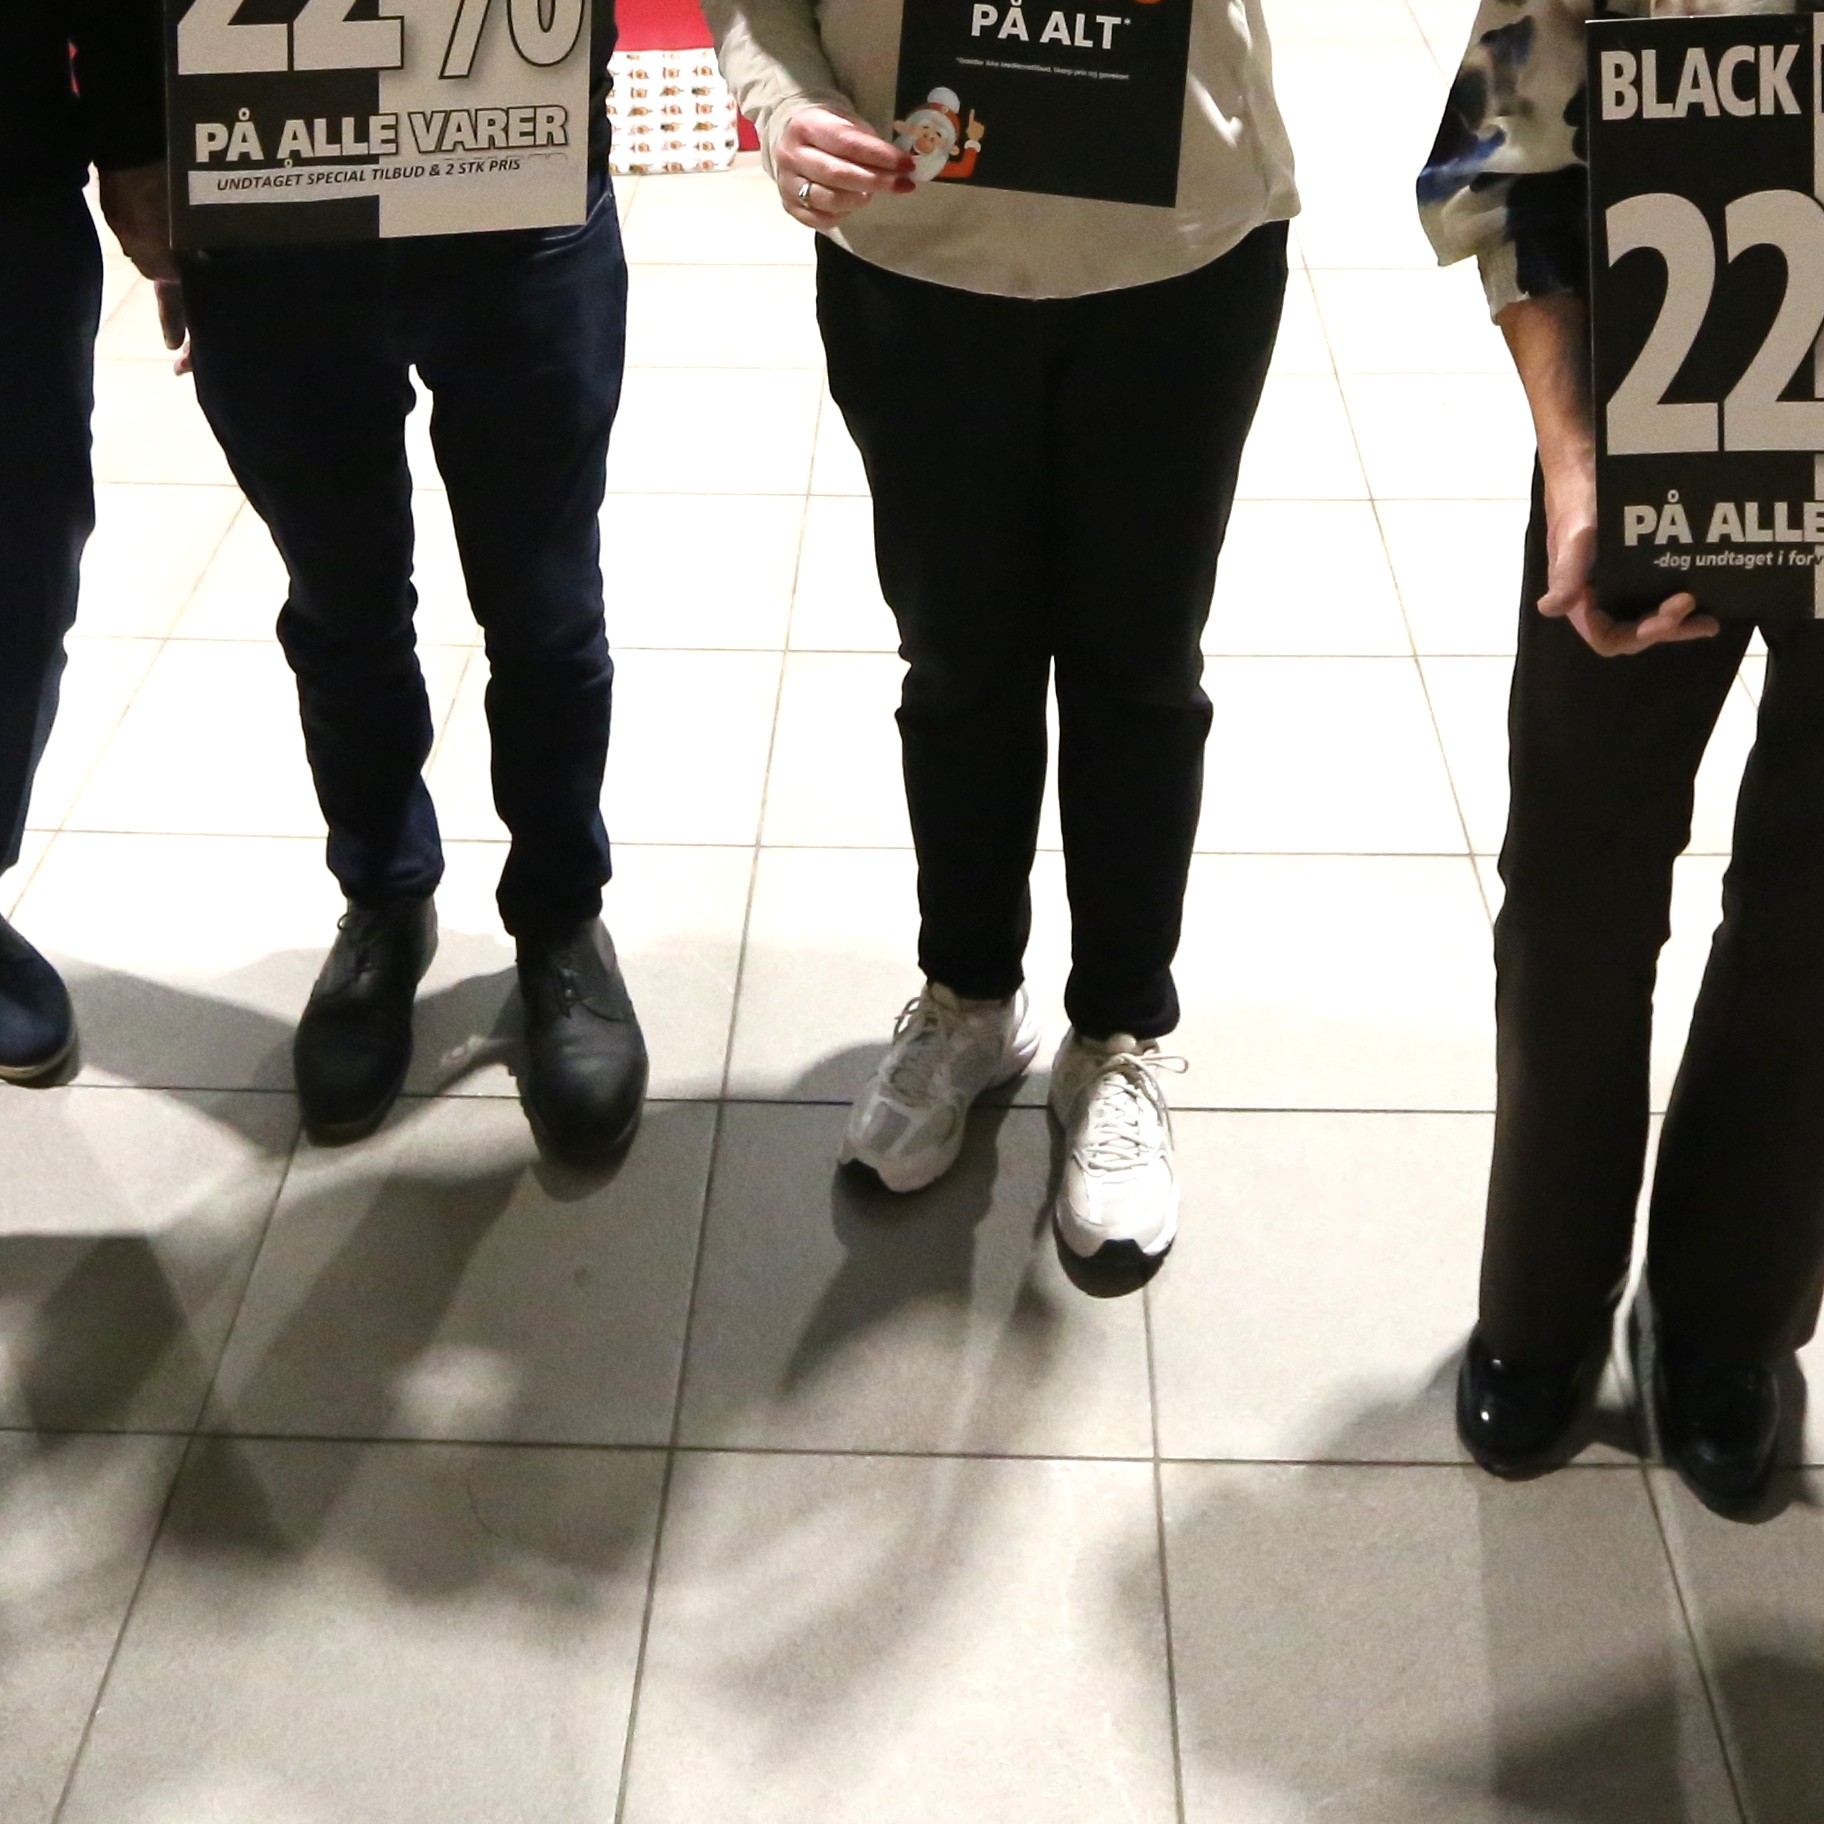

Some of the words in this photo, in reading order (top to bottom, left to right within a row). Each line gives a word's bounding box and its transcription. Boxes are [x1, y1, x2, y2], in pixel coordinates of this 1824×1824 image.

[1601, 44, 1801, 121] BLACK
[195, 107, 265, 164] PÅ
[277, 113, 399, 160] ALLE
[408, 104, 569, 155] VARER
[217, 173, 303, 192] UNDTAGET
[306, 170, 367, 186] SPECIAL
[371, 165, 424, 182] TILBUD
[429, 163, 440, 177] &
[445, 162, 454, 176] 2
[459, 159, 485, 175] STK
[489, 157, 520, 173] PRIS
[1624, 489, 1692, 546] PÅ
[1653, 551, 1691, 571] -dog
[1695, 550, 1774, 570] undtaget
